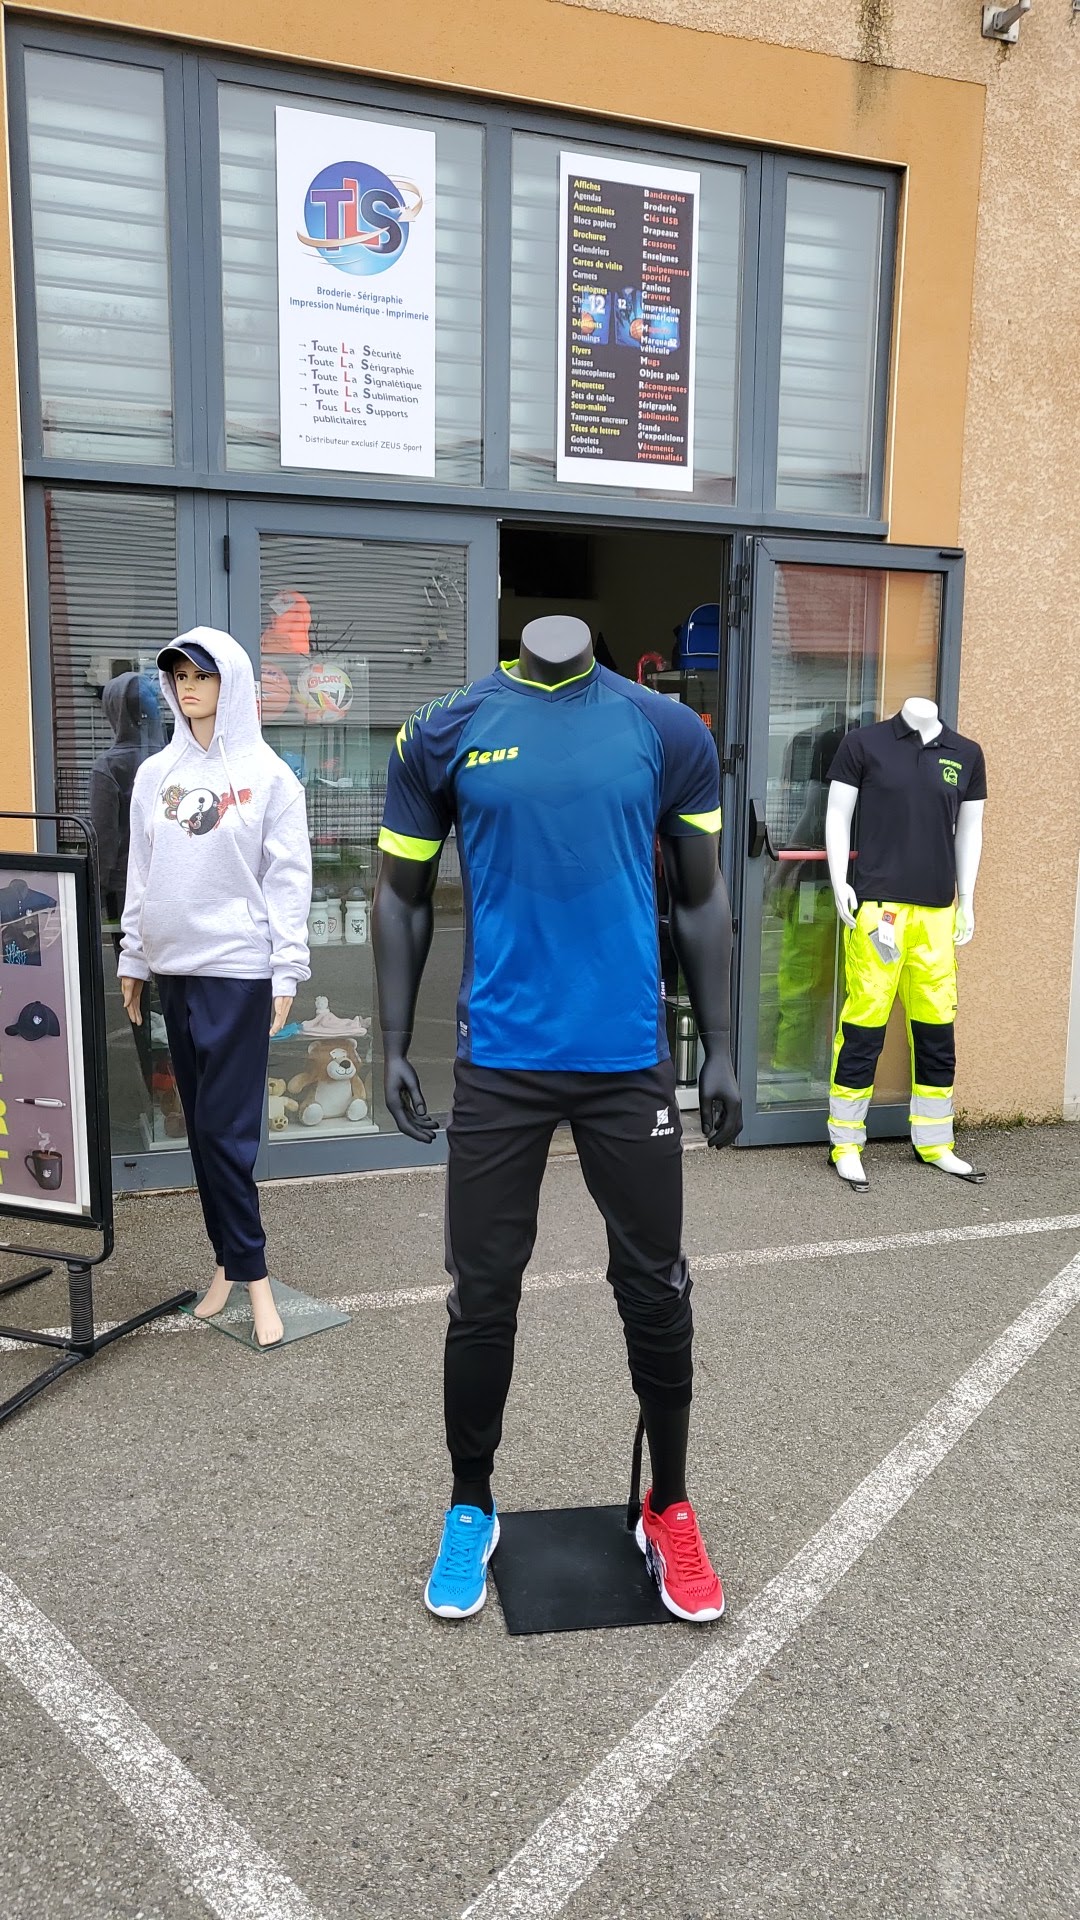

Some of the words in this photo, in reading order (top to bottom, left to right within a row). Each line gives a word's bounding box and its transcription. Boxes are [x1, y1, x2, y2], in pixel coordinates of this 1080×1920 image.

[574, 179, 601, 192] Affiches
[574, 191, 601, 202] Agendas
[644, 189, 686, 203] Banderoles
[574, 202, 615, 216] Autocollants
[644, 202, 677, 214] Broderie
[311, 178, 403, 255] TLS
[573, 216, 592, 226] Blocs
[593, 218, 617, 229] papiers
[643, 214, 660, 223] Clés
[662, 216, 679, 226] USB
[573, 229, 607, 242] Brochures
[643, 226, 679, 239] Drapeaux
[573, 244, 610, 257] Calendriers
[642, 238, 676, 251] Ecussons
[642, 251, 679, 264] Enseignes
[573, 257, 594, 268] Cartes
[595, 259, 604, 269] de
[605, 261, 623, 272] visite
[642, 263, 690, 277] Equipements
[573, 270, 598, 281] Carnets
[641, 273, 671, 283] sportifs
[572, 283, 608, 295] Catalogues
[641, 282, 671, 294] Fanions
[317, 286, 352, 299] Broderie
[357, 291, 403, 305] Sérigraphie
[641, 291, 671, 302] Gravure
[289, 297, 334, 311] Impression
[336, 302, 380, 316] Numérique
[386, 308, 429, 321] Imprimerie
[589, 295, 605, 314] 12
[618, 298, 627, 309] 12
[641, 303, 681, 315] Impression
[641, 312, 679, 323] numérique
[311, 340, 338, 354] Toute
[342, 342, 355, 355] La
[363, 345, 402, 360] Sécurité
[571, 345, 591, 356] Flyers
[308, 354, 335, 367] Toute
[340, 356, 354, 369] La
[361, 359, 414, 376] Sérigraphie
[571, 357, 593, 367] Liasses
[640, 356, 660, 367] Mugs
[311, 369, 338, 382] Toute
[344, 371, 357, 384] La
[364, 374, 422, 391] Signalétique
[639, 368, 664, 380] Objets
[665, 371, 680, 381] pub
[571, 379, 605, 391] Plaquettes
[638, 381, 688, 393] Récompenses
[312, 384, 339, 396] Toute
[345, 386, 358, 398] La
[363, 388, 419, 404] Sublimation
[570, 391, 585, 401] Sets
[586, 392, 595, 401] de
[596, 393, 615, 403] tables
[638, 390, 672, 400] sportives
[316, 399, 338, 412] Tous
[344, 401, 361, 414] Les
[366, 404, 408, 418] Supports
[570, 401, 607, 412] Sous-mains
[638, 401, 677, 412] Sérigraphie
[313, 414, 367, 426] publicitaires
[570, 412, 600, 423] Tampons
[601, 416, 629, 425] encreurs
[638, 411, 679, 422] Sublimation
[570, 423, 589, 433] Têtes
[590, 425, 598, 434] de
[599, 426, 620, 436] lettres
[637, 422, 661, 432] Stands
[305, 435, 350, 446] Distributeur
[351, 439, 378, 449] exclusif
[380, 441, 401, 449] ZEUS
[403, 443, 422, 452] Sport
[570, 435, 599, 445] Gobelets
[637, 442, 674, 453] Vêtements
[637, 452, 683, 462] personnalisés
